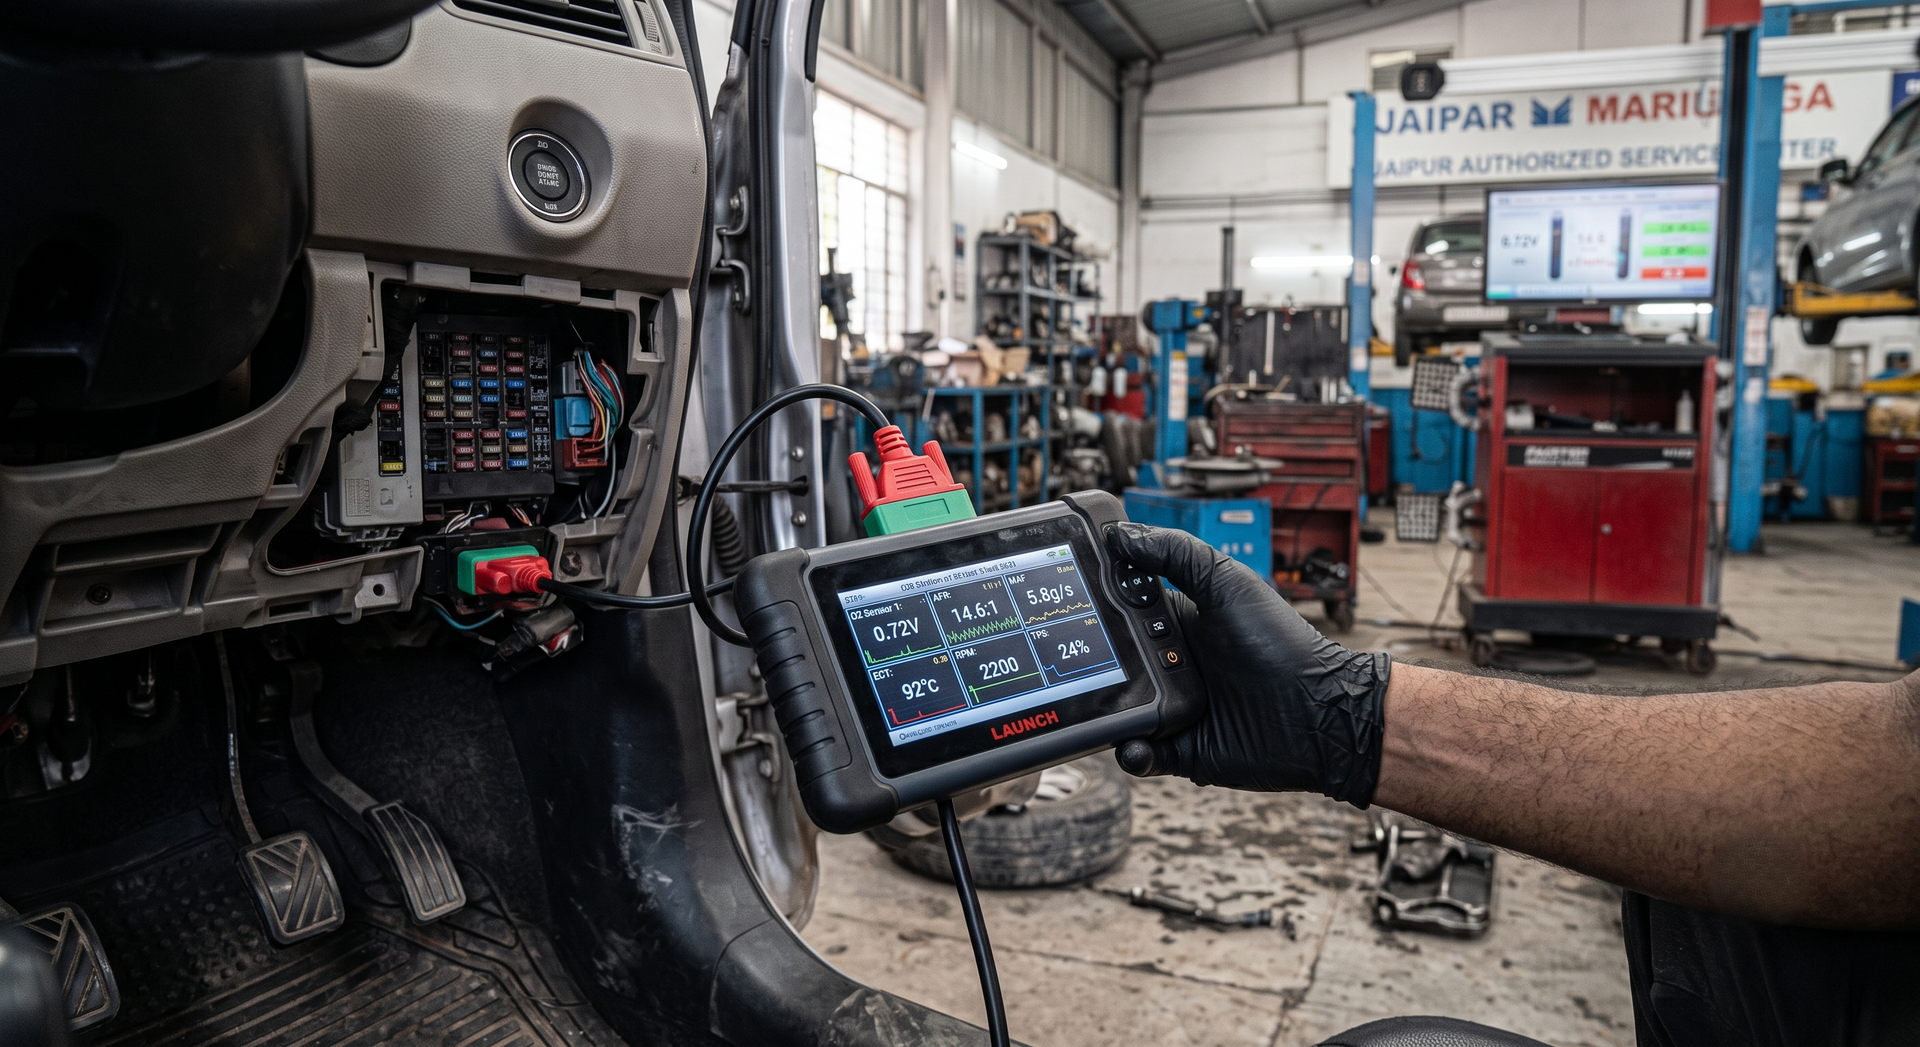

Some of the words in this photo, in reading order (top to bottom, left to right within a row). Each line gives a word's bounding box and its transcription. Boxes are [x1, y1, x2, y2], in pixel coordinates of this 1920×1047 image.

[1375, 102, 1514, 134] JAIPAR
[1459, 147, 1613, 175] AUTHORIZED
[1007, 574, 1026, 585] MAF
[933, 591, 952, 602] AFR:
[1026, 584, 1074, 605] 5.8g/s
[893, 603, 903, 611] 1:
[951, 600, 999, 624] 14.6:1
[872, 618, 919, 642] 0.72V
[1030, 629, 1050, 640] TPS:
[954, 648, 977, 660] RPM:
[1057, 640, 1090, 660] 24%
[873, 668, 894, 681] ECT:
[979, 657, 1019, 680] 2200
[901, 678, 940, 700] 92°C
[990, 710, 1060, 741] LAUNCH
